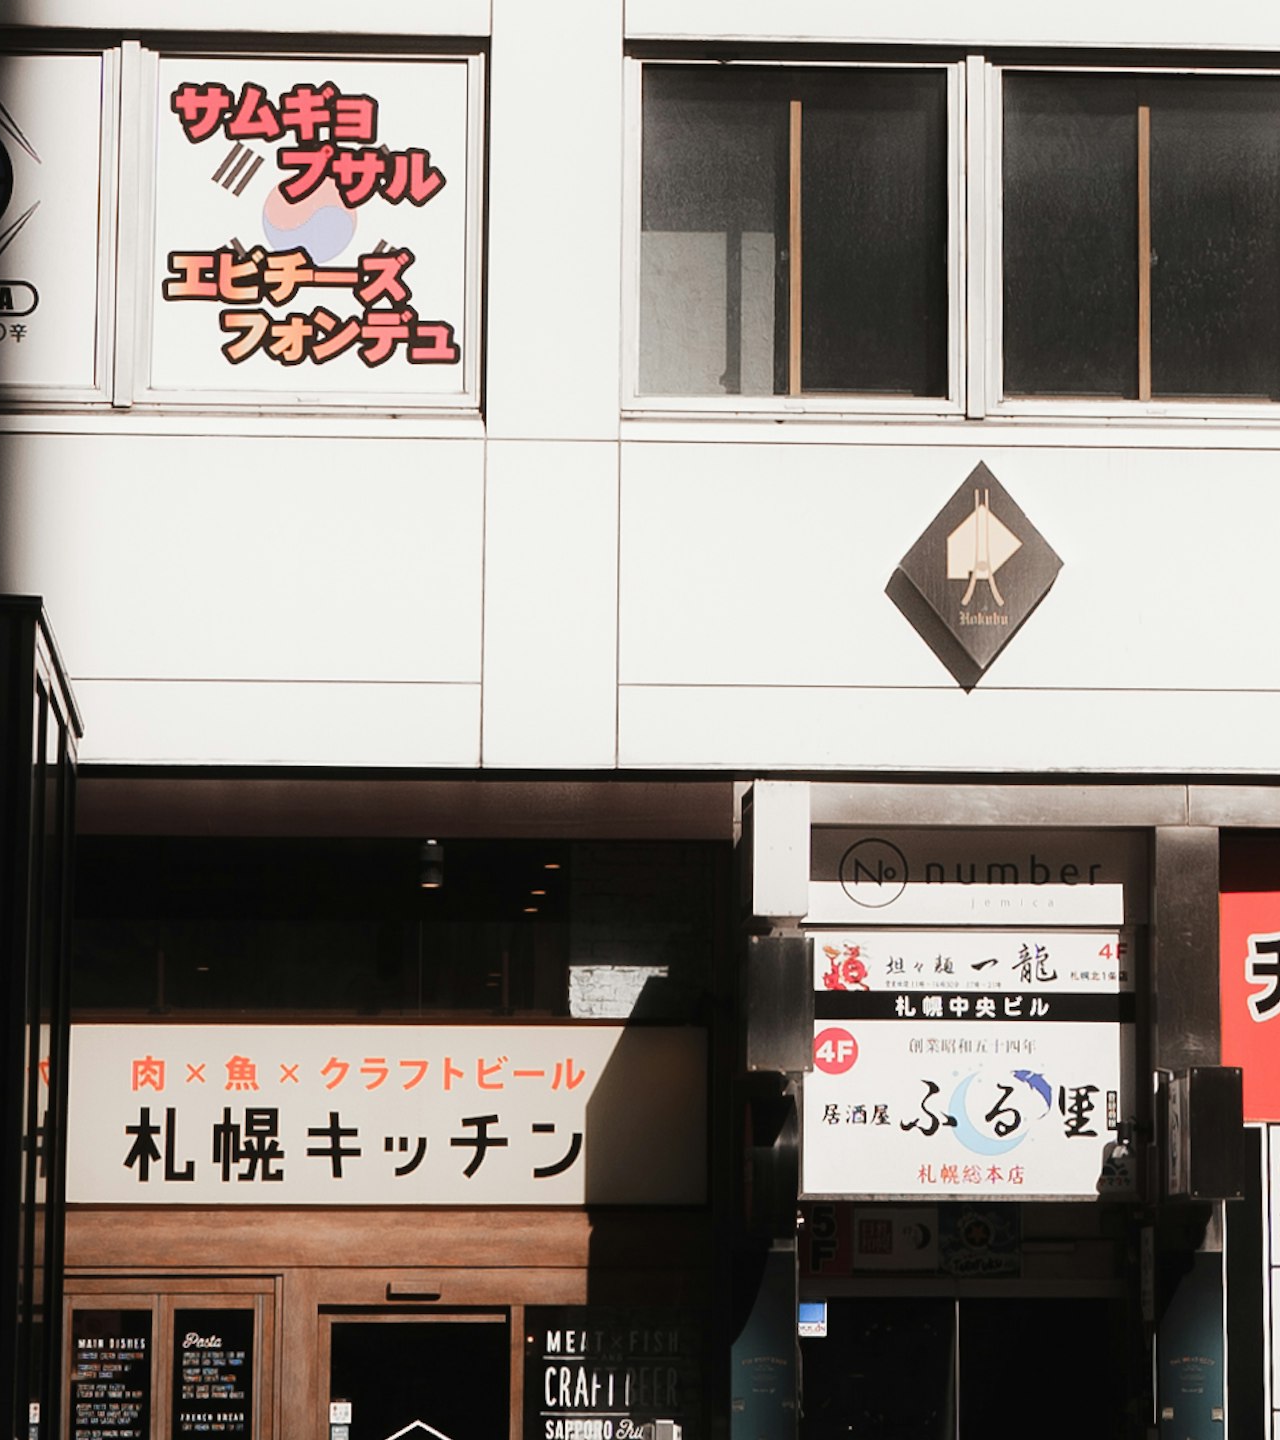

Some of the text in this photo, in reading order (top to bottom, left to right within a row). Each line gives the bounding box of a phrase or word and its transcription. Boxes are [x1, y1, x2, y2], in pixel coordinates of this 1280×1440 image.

[171, 81, 379, 144] サムギョ
[278, 145, 445, 206] プサル
[162, 246, 413, 304] エビチーズ
[220, 307, 460, 369] フォンデュ
[925, 854, 1102, 886] number
[895, 995, 1050, 1019] 札幌中央ビル
[816, 1039, 855, 1064] 4F
[124, 1106, 584, 1182] 札幌キッチン
[917, 1163, 1025, 1185] 札幌総本店
[182, 1332, 222, 1348] Pasta
[544, 1366, 617, 1407] CRAFT
